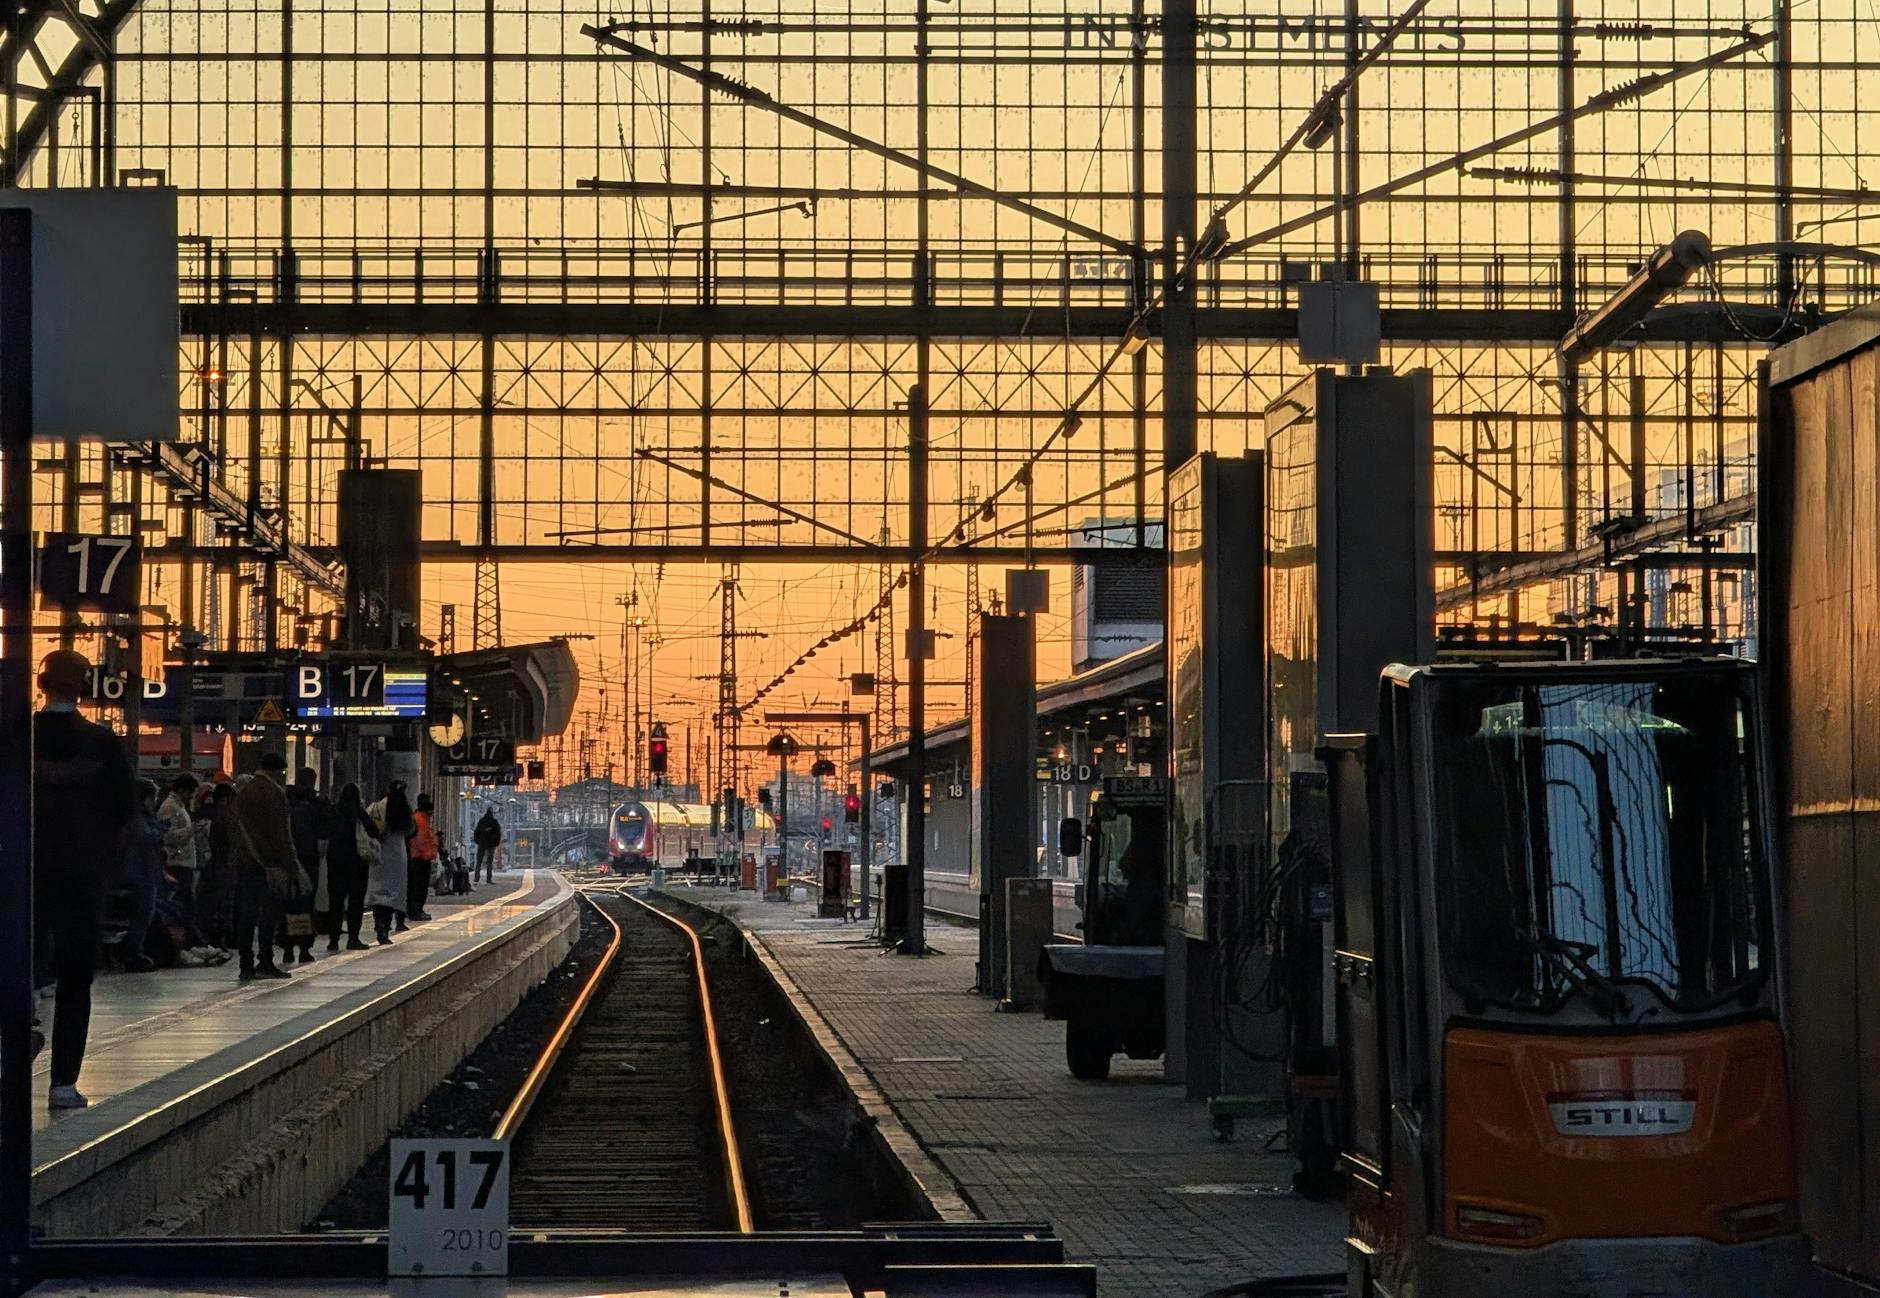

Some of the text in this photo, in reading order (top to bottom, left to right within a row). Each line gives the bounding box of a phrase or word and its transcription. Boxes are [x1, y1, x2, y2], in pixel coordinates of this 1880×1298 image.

[1064, 14, 1466, 51] INVSTMENTS
[67, 538, 132, 594] 17
[299, 665, 378, 699] B 17
[477, 739, 501, 760] 17
[1055, 765, 1091, 781] 18 D
[948, 784, 963, 797] 18
[1567, 1107, 1679, 1126] STILL
[394, 1151, 504, 1209] 417
[443, 1229, 503, 1251] 2010
